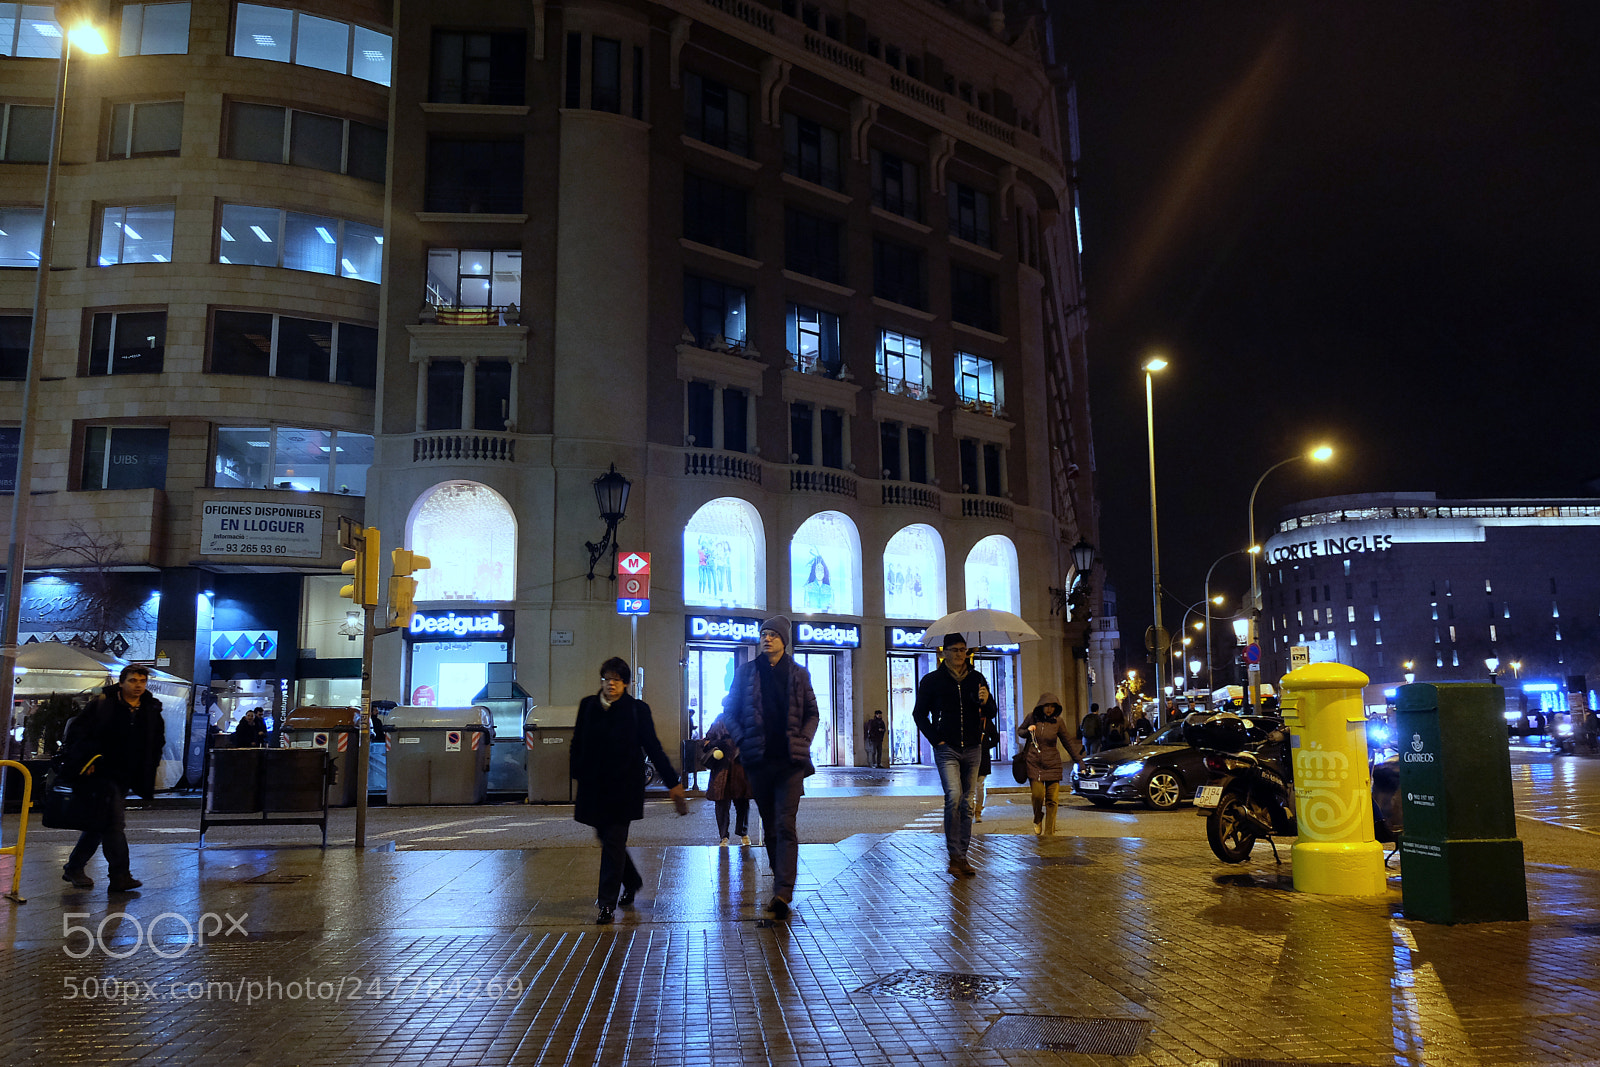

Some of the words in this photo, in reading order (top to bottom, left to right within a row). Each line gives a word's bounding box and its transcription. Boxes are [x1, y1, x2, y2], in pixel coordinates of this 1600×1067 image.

[113, 454, 138, 465] UIBS
[205, 505, 252, 515] OFICINES
[255, 506, 321, 519] DISPONIBLES
[221, 518, 239, 531] EN
[244, 519, 304, 534] LLOGUER
[226, 543, 238, 553] 93
[240, 544, 258, 554] 265
[260, 544, 272, 554] 93
[274, 545, 287, 554] 60
[1273, 540, 1318, 562] CORTE
[1323, 534, 1393, 556] INGLES
[628, 558, 639, 568] M
